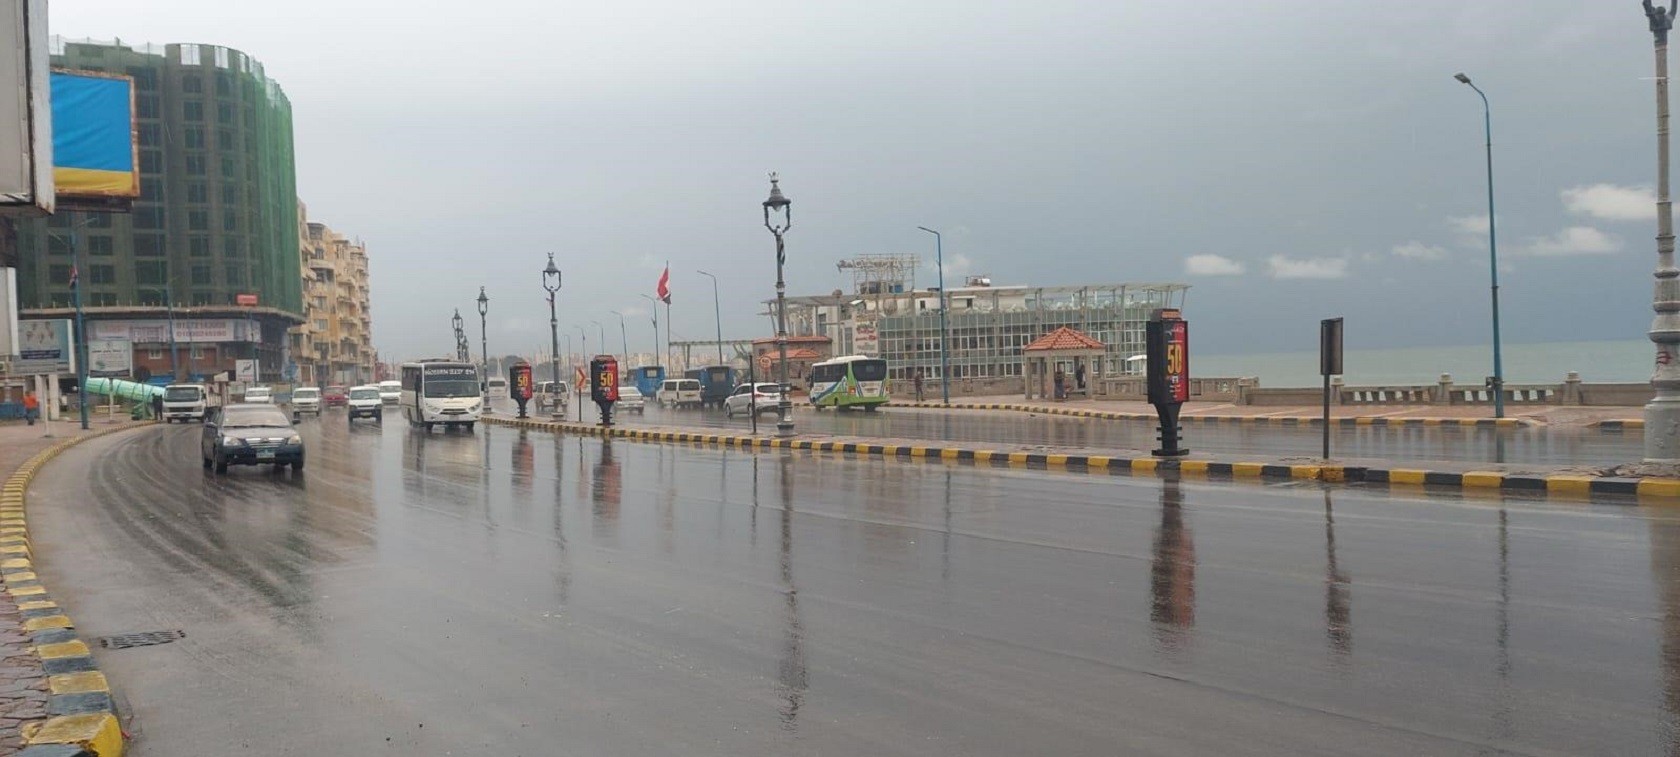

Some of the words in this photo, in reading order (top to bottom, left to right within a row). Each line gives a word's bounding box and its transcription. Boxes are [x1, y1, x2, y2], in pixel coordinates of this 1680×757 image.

[1167, 344, 1182, 374] 50
[517, 376, 528, 387] 50
[600, 372, 613, 387] 50
